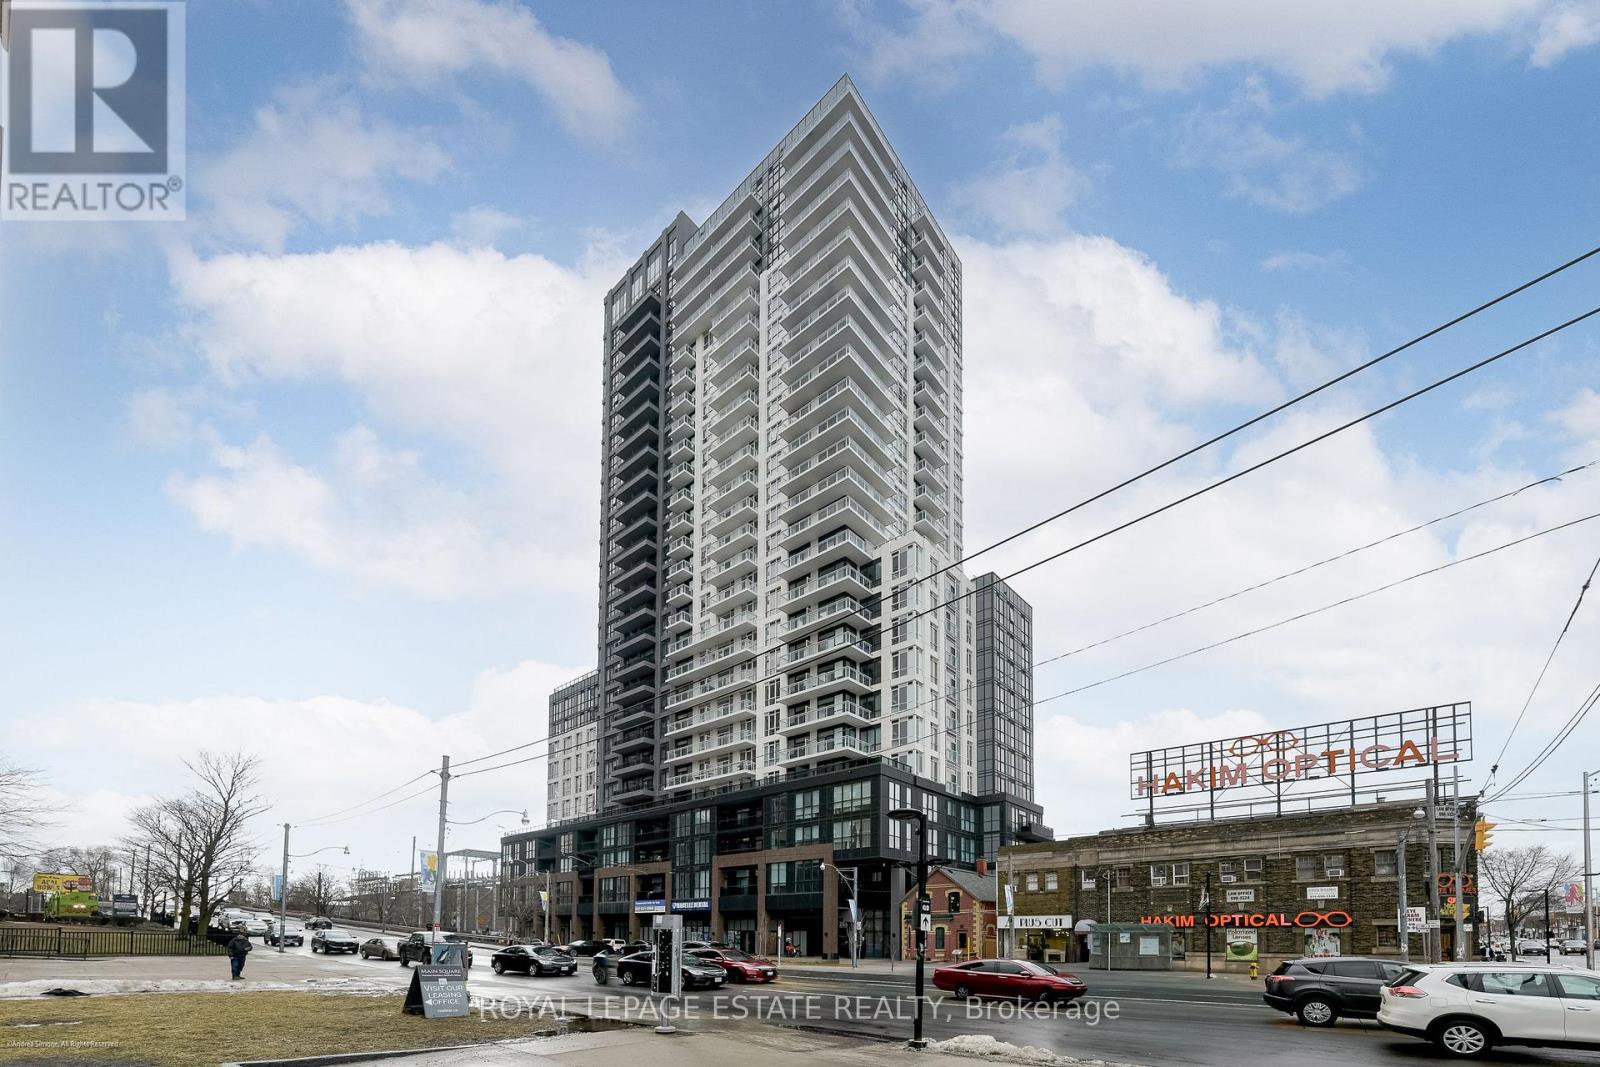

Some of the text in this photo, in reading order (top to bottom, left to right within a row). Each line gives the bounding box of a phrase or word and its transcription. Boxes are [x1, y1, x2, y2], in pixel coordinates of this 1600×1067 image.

[1137, 736, 1460, 796] HAKIM OPTICAL
[1044, 918, 1063, 927] CUT
[1140, 912, 1292, 927] HAKIM OPTICAL
[428, 991, 462, 999] LEASING
